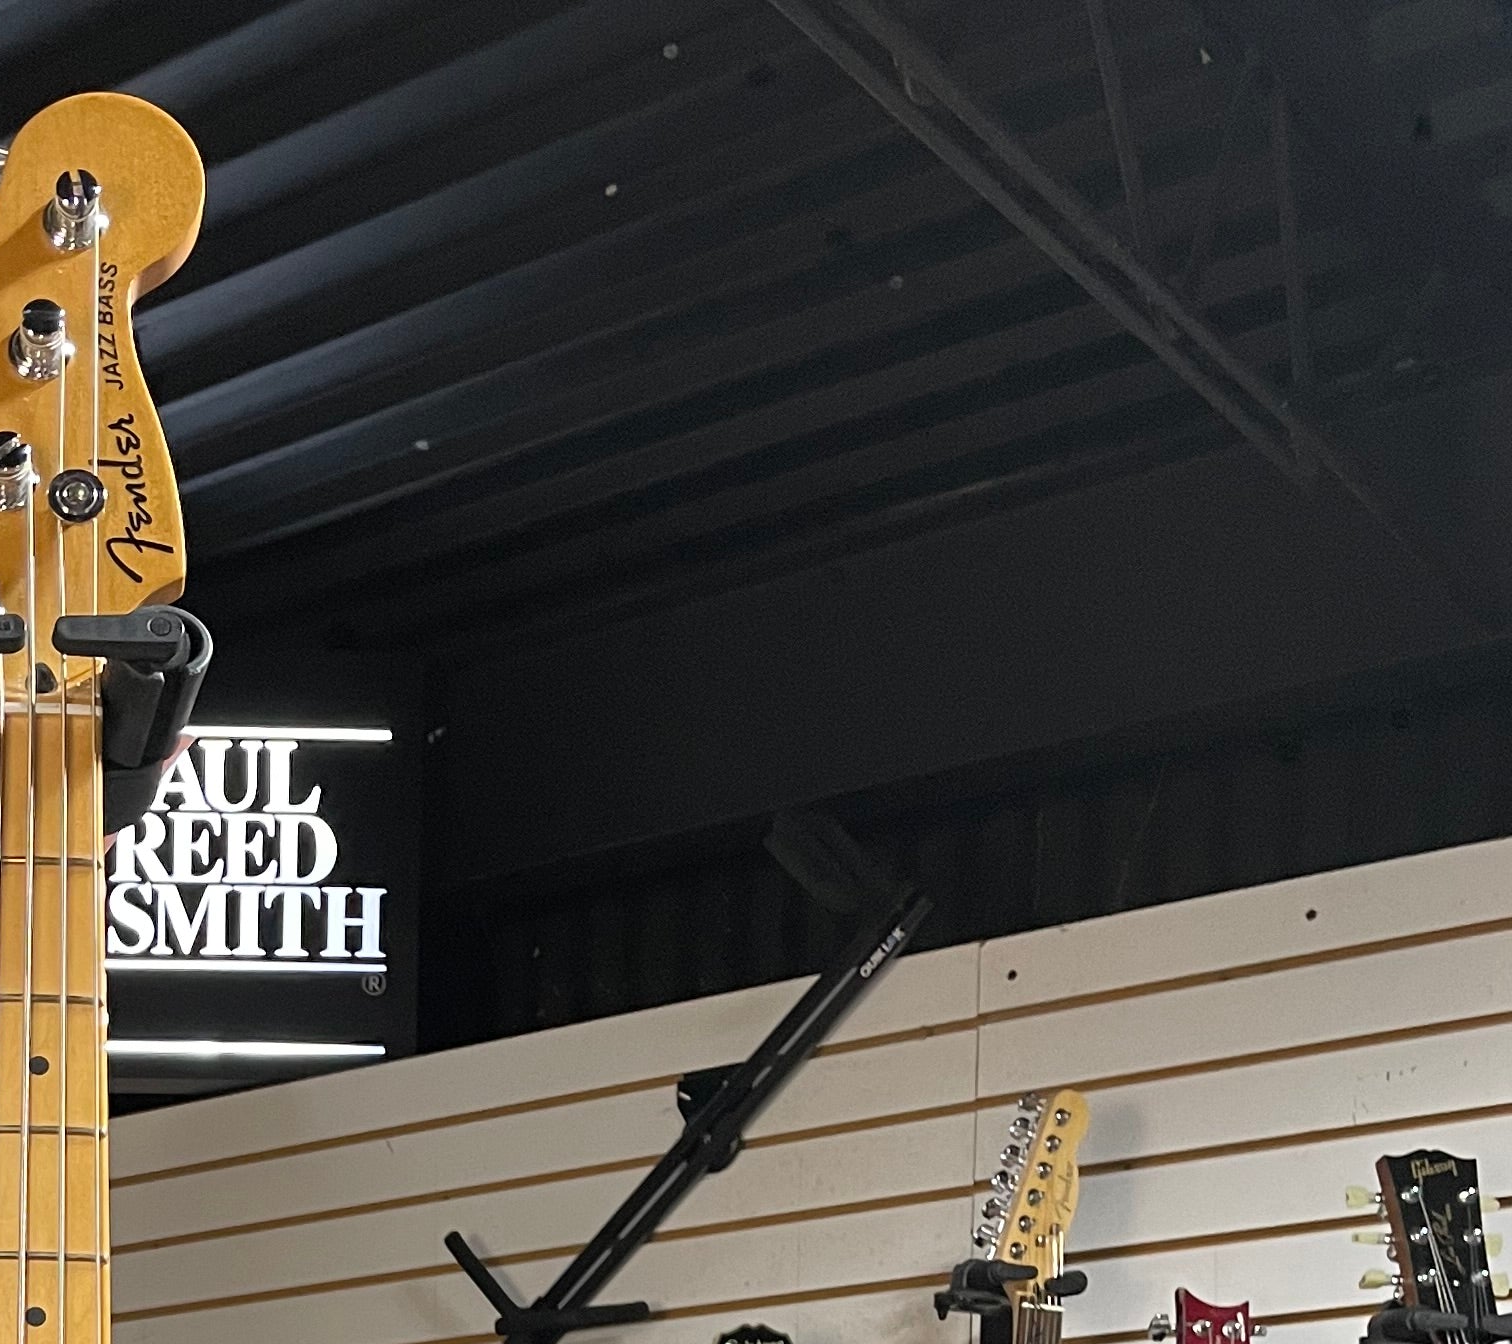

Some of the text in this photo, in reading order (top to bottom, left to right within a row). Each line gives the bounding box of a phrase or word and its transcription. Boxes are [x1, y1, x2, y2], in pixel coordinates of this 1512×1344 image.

[99, 262, 123, 391] JAZZ BASS
[88, 412, 175, 584] Fender
[151, 740, 321, 814] AUL
[108, 812, 338, 885] REED
[107, 884, 387, 958] SMITH
